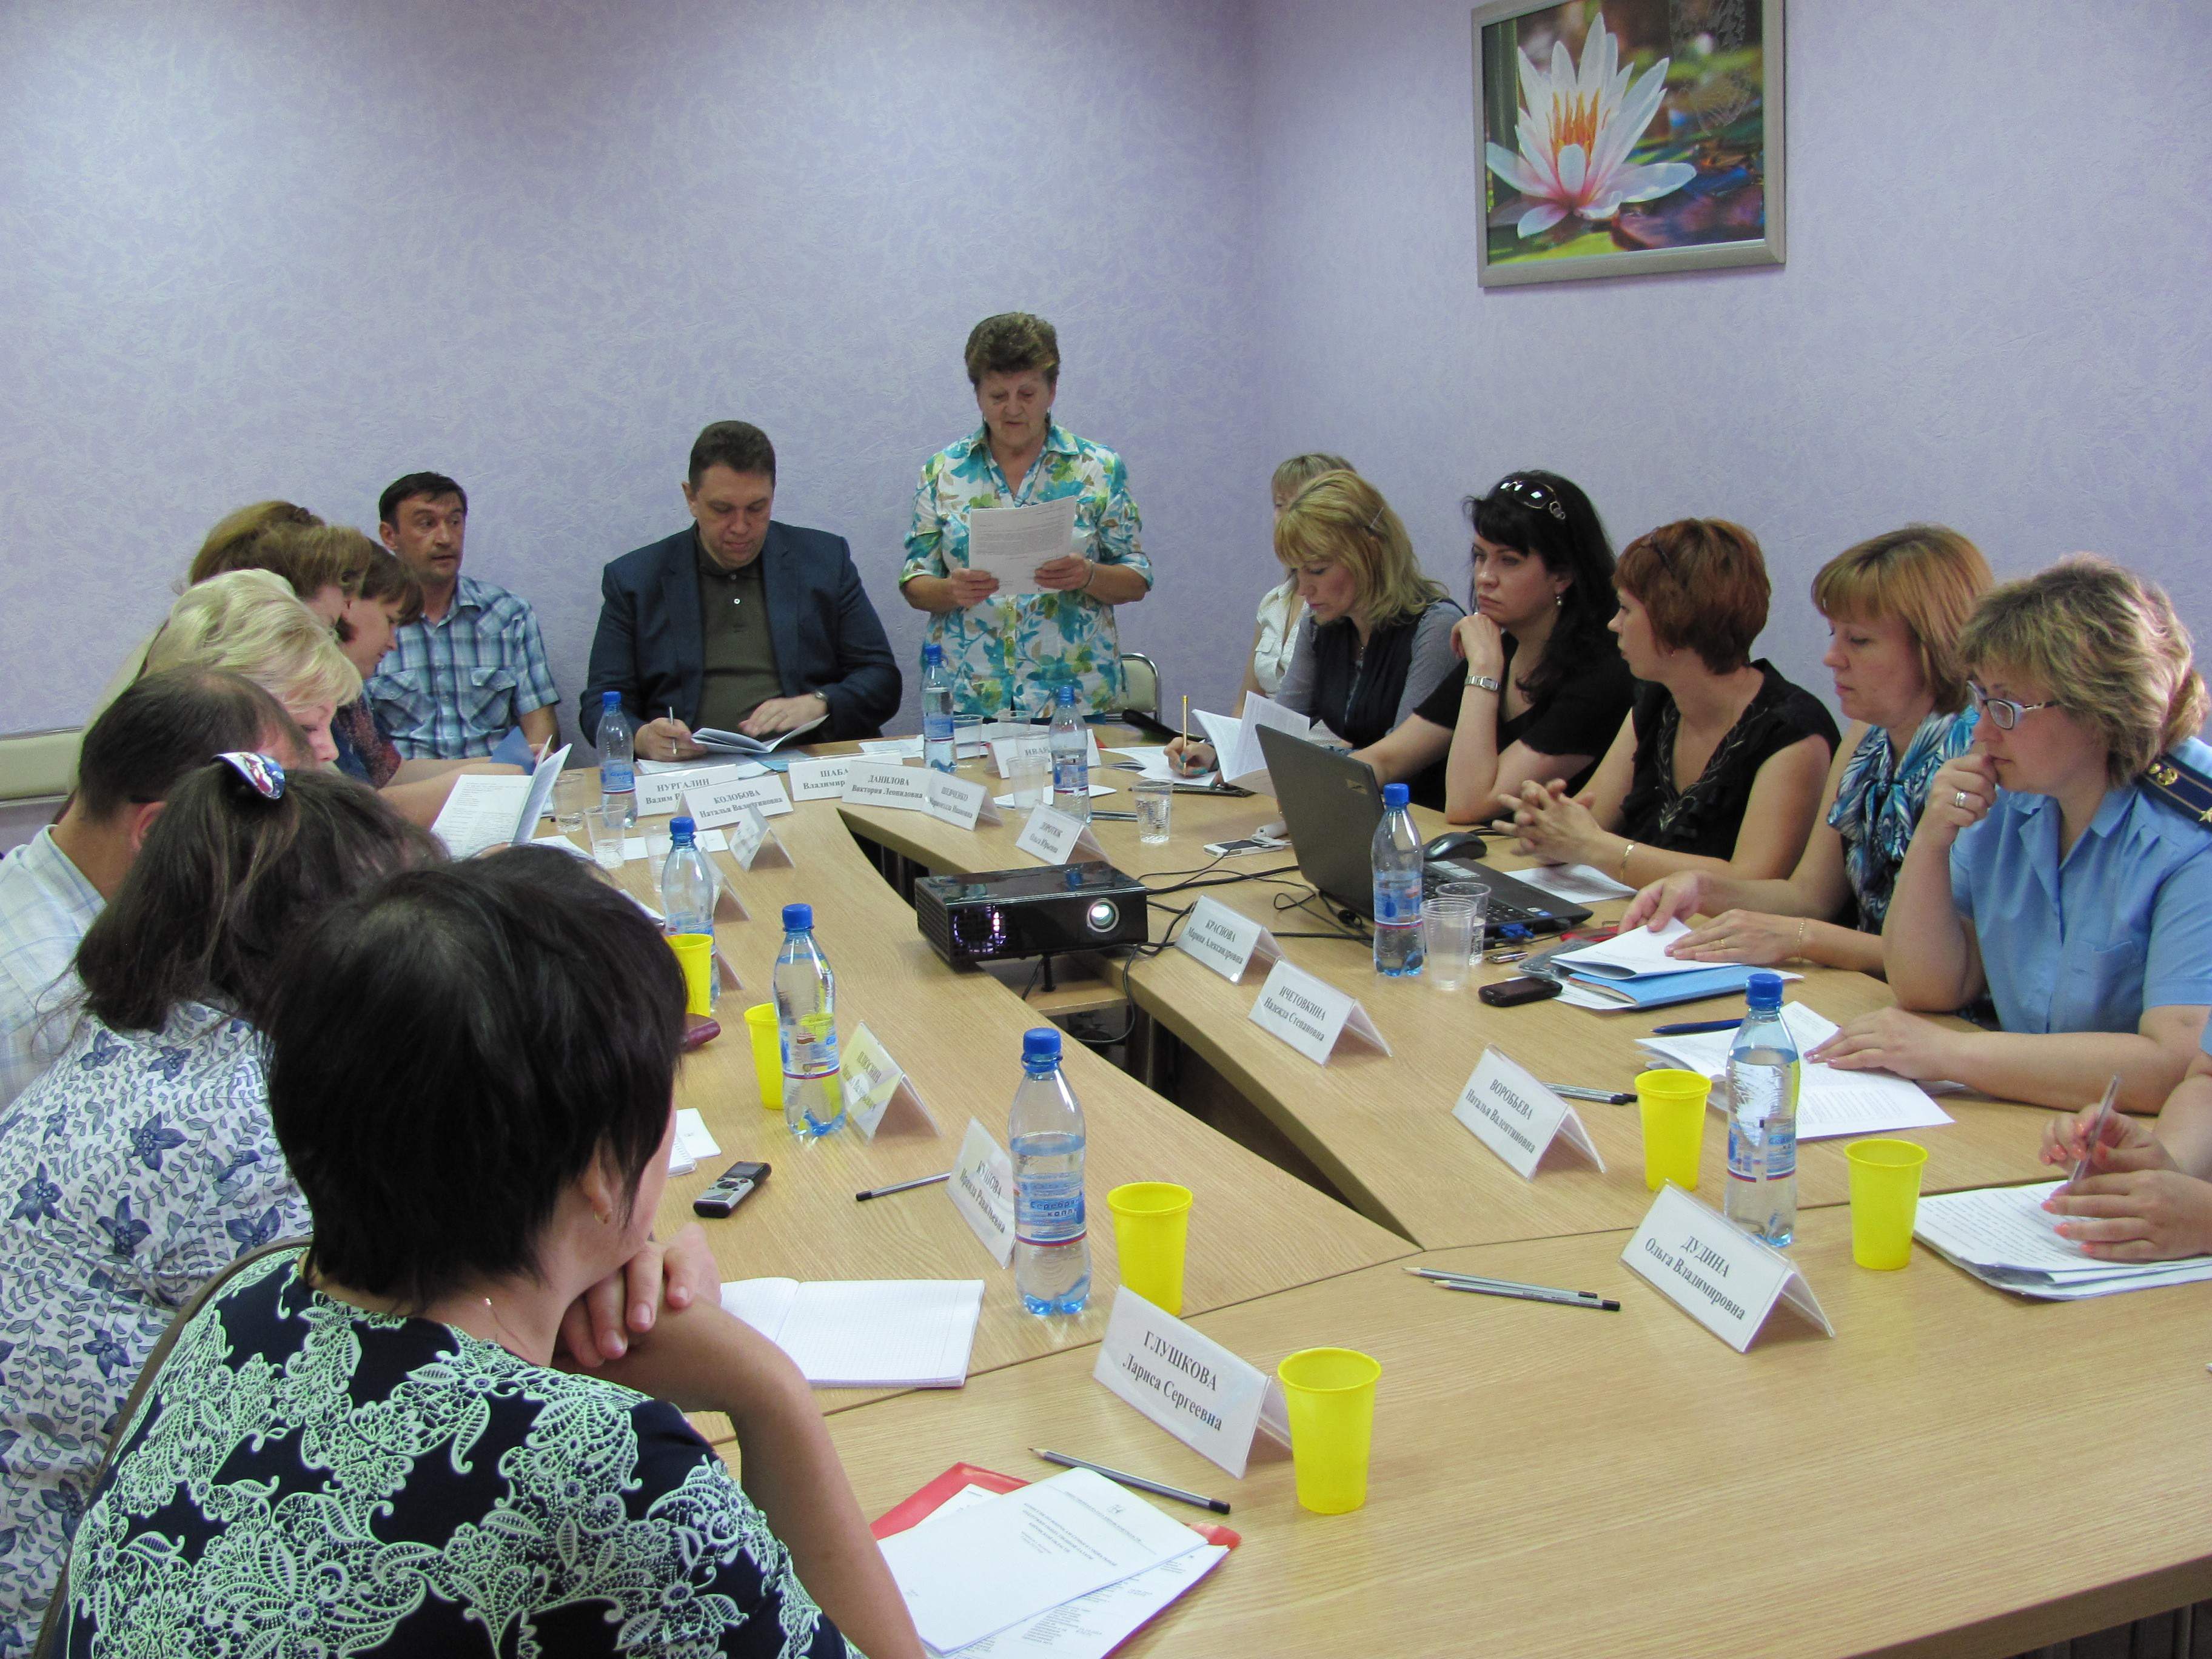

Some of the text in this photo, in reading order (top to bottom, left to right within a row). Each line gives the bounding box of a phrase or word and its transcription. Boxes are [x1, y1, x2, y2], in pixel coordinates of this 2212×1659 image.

[657, 778, 710, 793] НУРГАЛИН
[803, 780, 845, 790] Владимир
[851, 784, 882, 796] Виктория
[868, 775, 910, 786] ДАНИЛОВА
[645, 794, 673, 805] Вадим
[713, 789, 761, 805] КОЛОБОВА
[699, 806, 731, 819] Наталья
[1205, 919, 1236, 942] КРАСНОВА
[1279, 985, 1327, 1021] ИЧЕТОВКИНА
[1264, 997, 1325, 1042] Надежда Степановна
[1489, 1078, 1533, 1121] ВОРОБЬЕВА
[1465, 1088, 1536, 1154] Наталья Валентиновна
[1680, 1235, 1731, 1278] ДУДИНА
[1644, 1238, 1746, 1321] Ольга Владимировна
[1143, 1330, 1217, 1392] ГЛУШКОВА
[1122, 1353, 1222, 1432] Лариса Сергеевна
